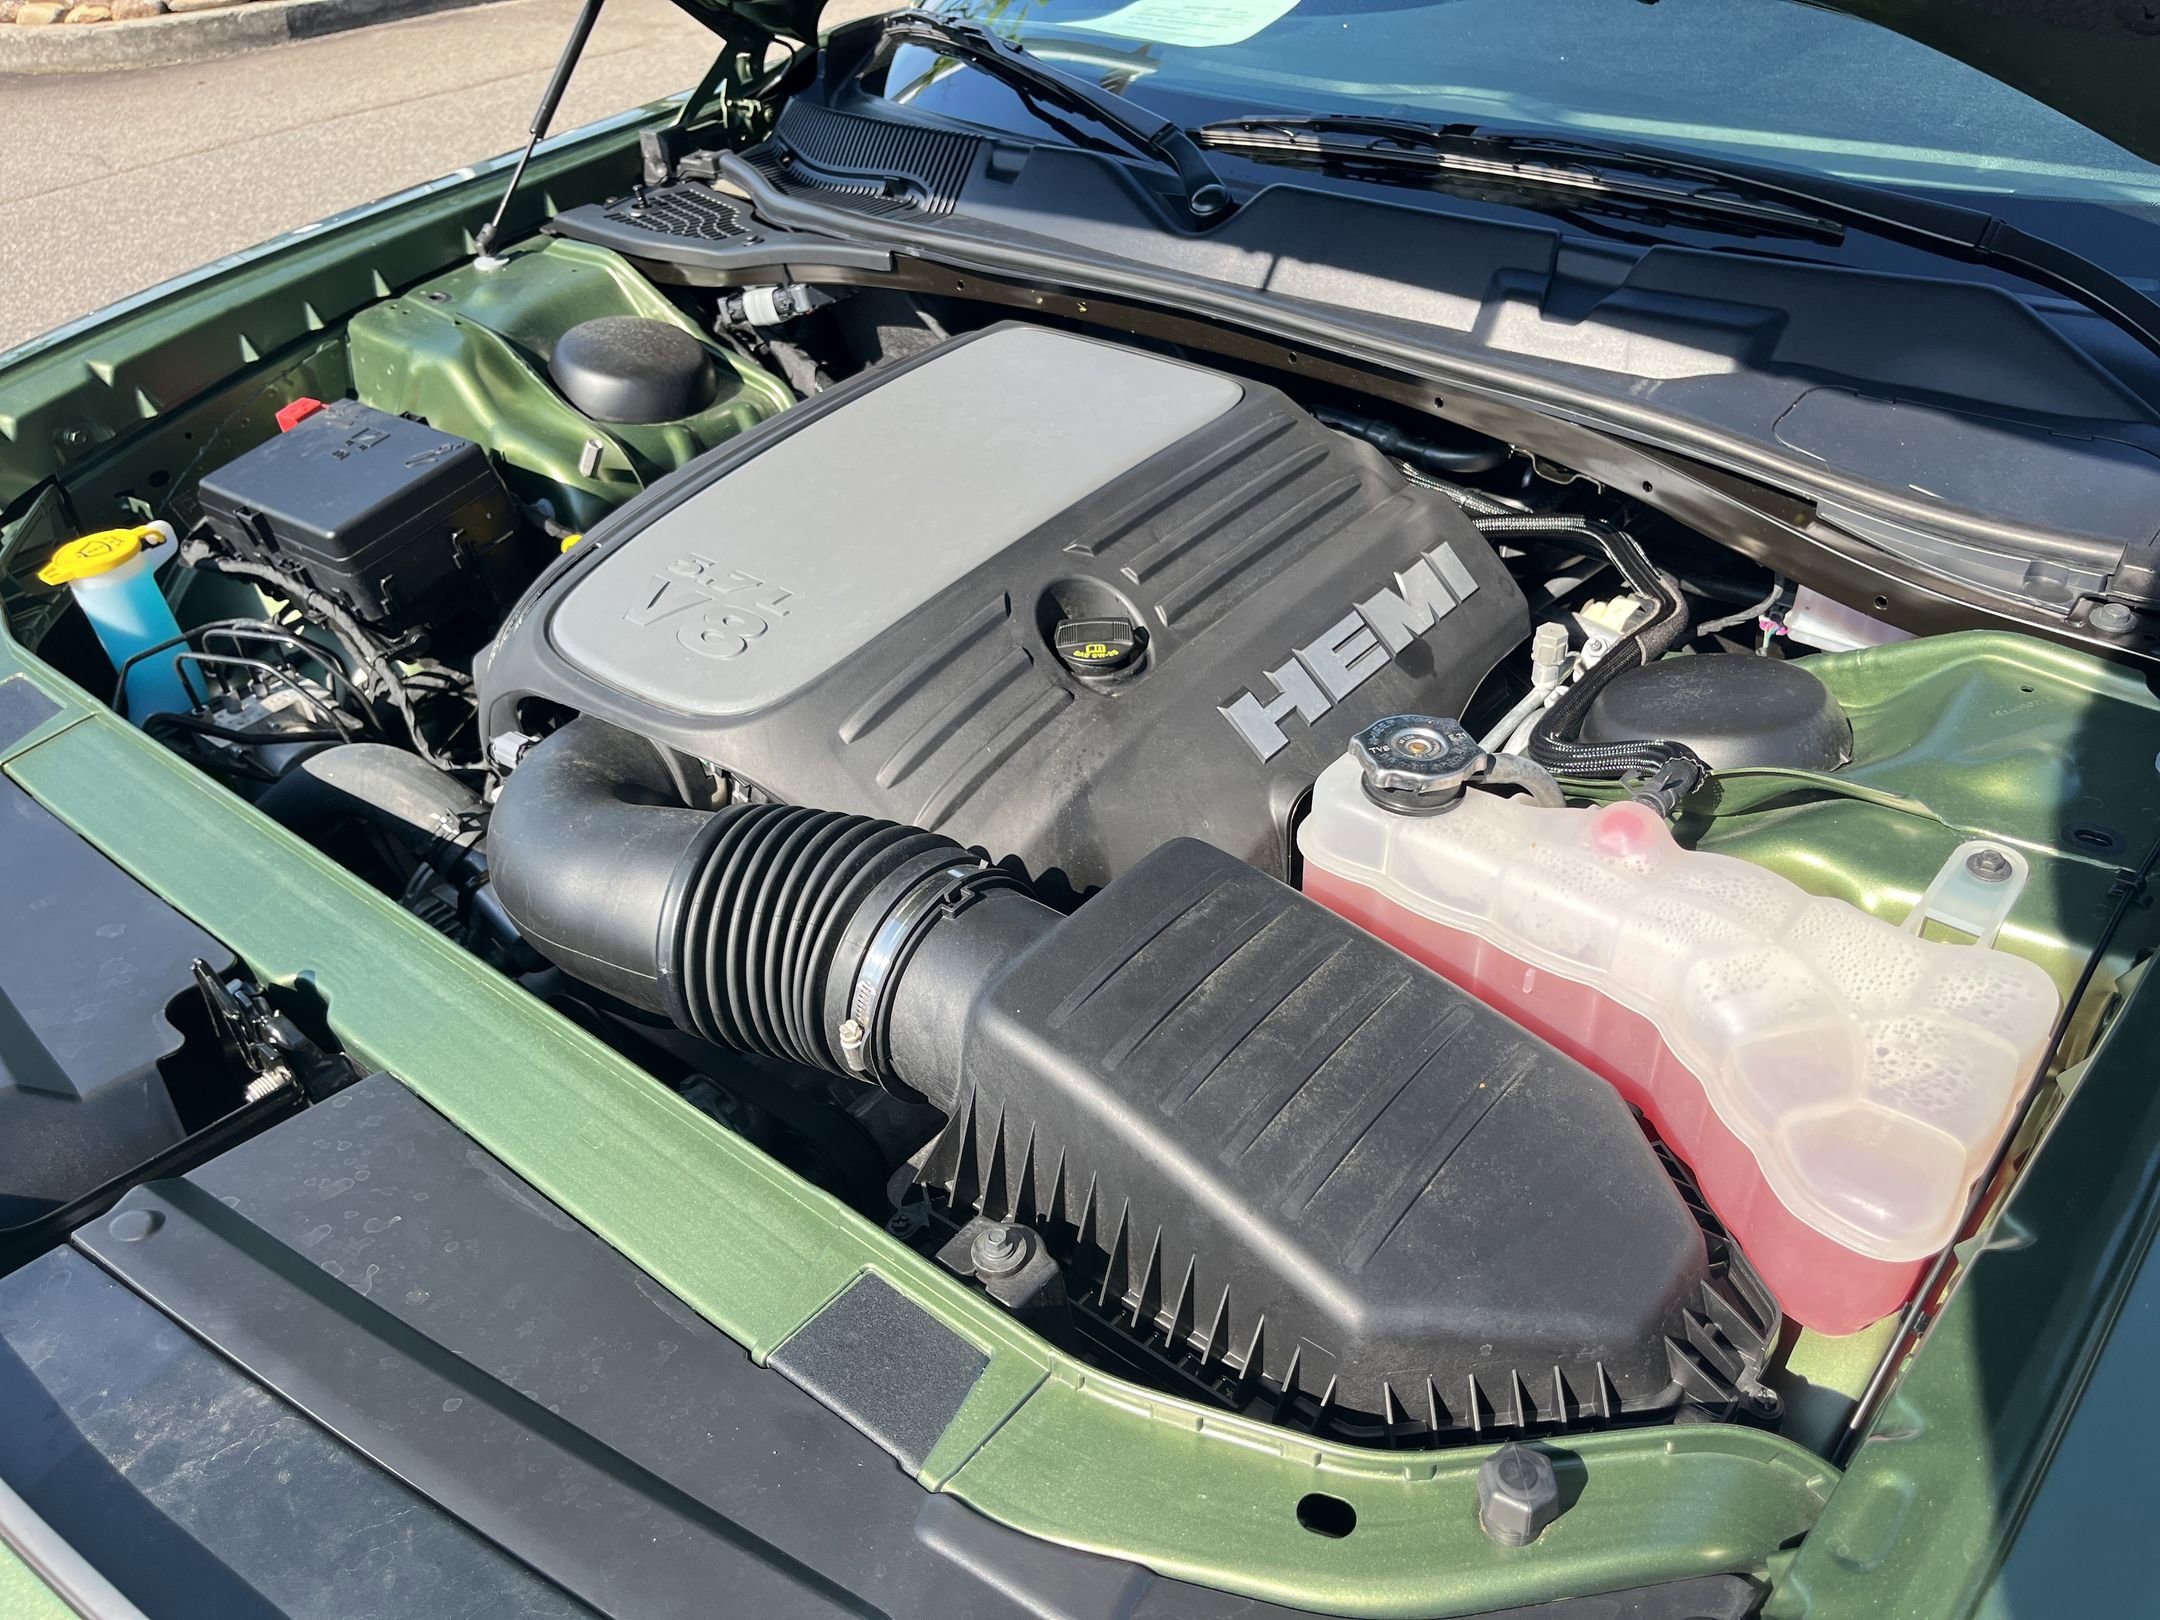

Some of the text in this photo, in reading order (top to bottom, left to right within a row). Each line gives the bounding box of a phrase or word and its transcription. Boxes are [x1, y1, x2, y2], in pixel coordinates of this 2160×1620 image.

[622, 574, 769, 660] V8
[666, 552, 794, 617] 5.7L
[1216, 540, 1480, 765] HEMI
